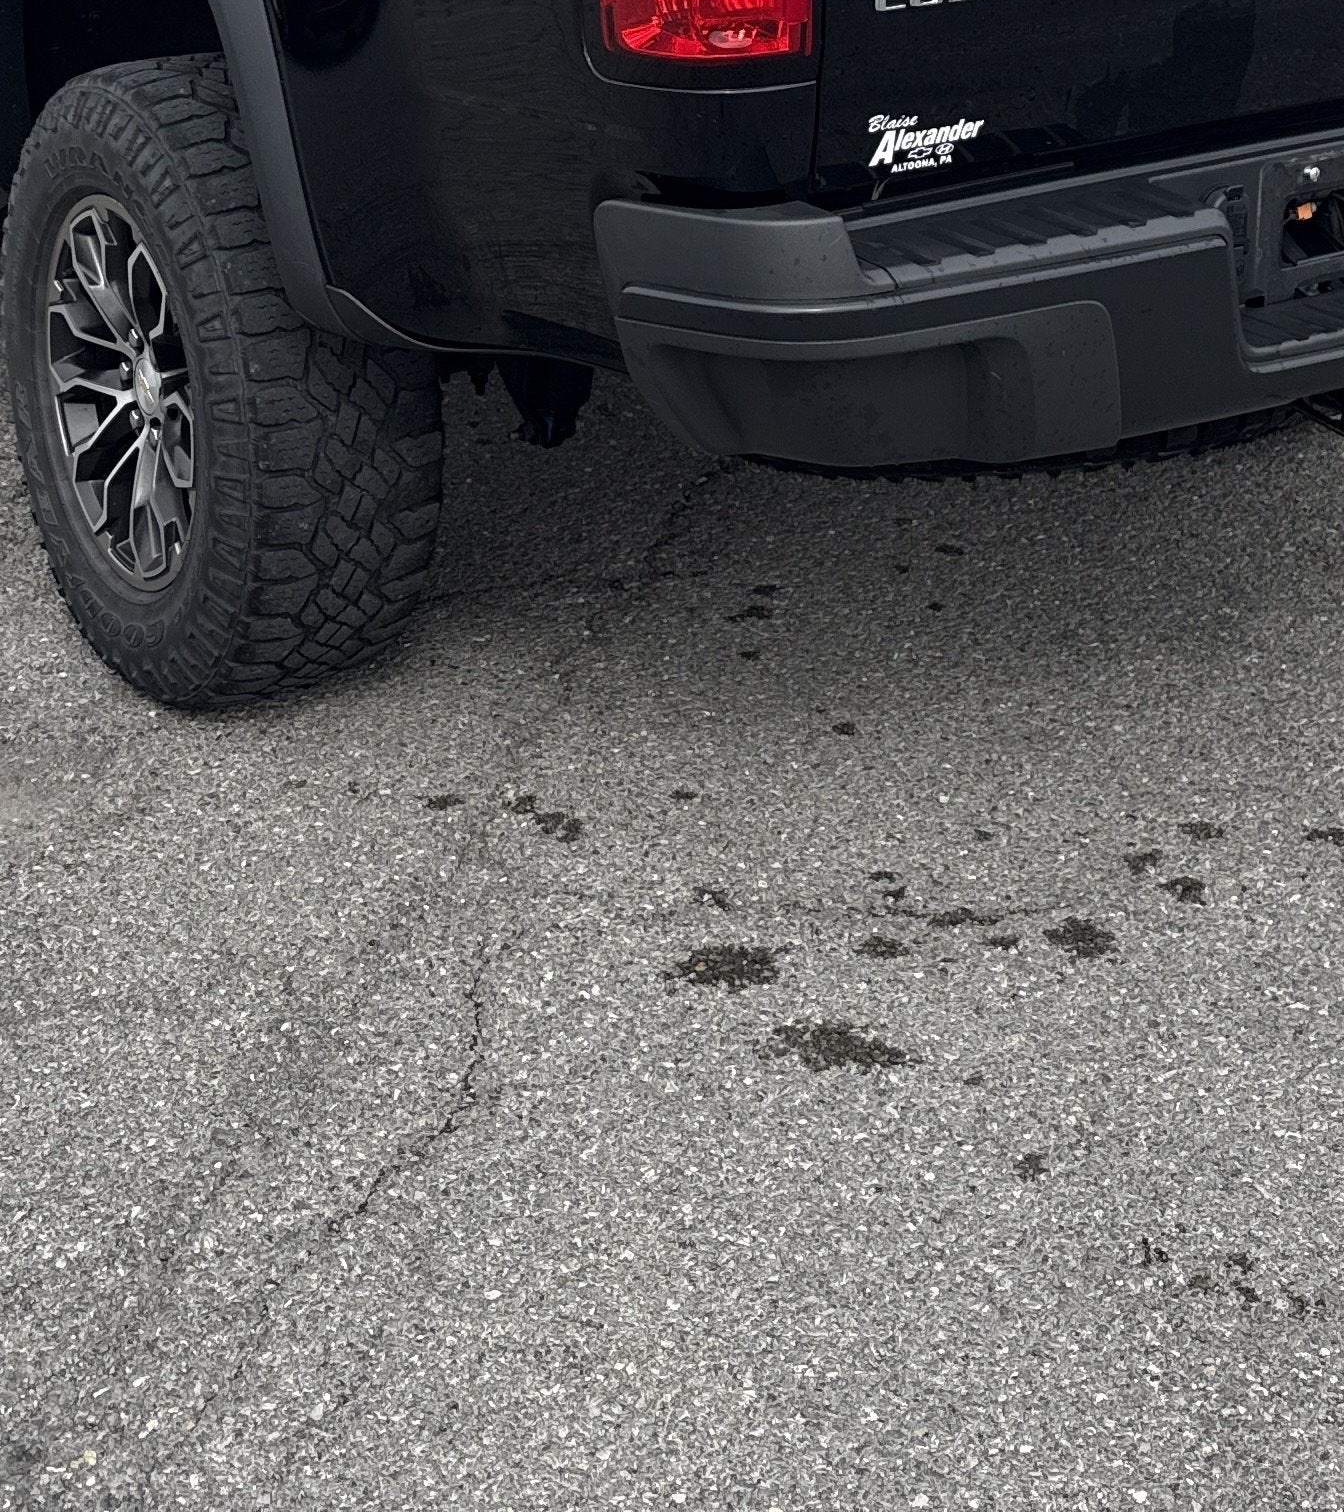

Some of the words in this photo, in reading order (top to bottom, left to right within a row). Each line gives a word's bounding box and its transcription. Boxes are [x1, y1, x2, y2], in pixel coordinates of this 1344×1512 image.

[868, 112, 919, 133] Blaise
[868, 118, 985, 167] Alexander
[939, 154, 953, 165] PA
